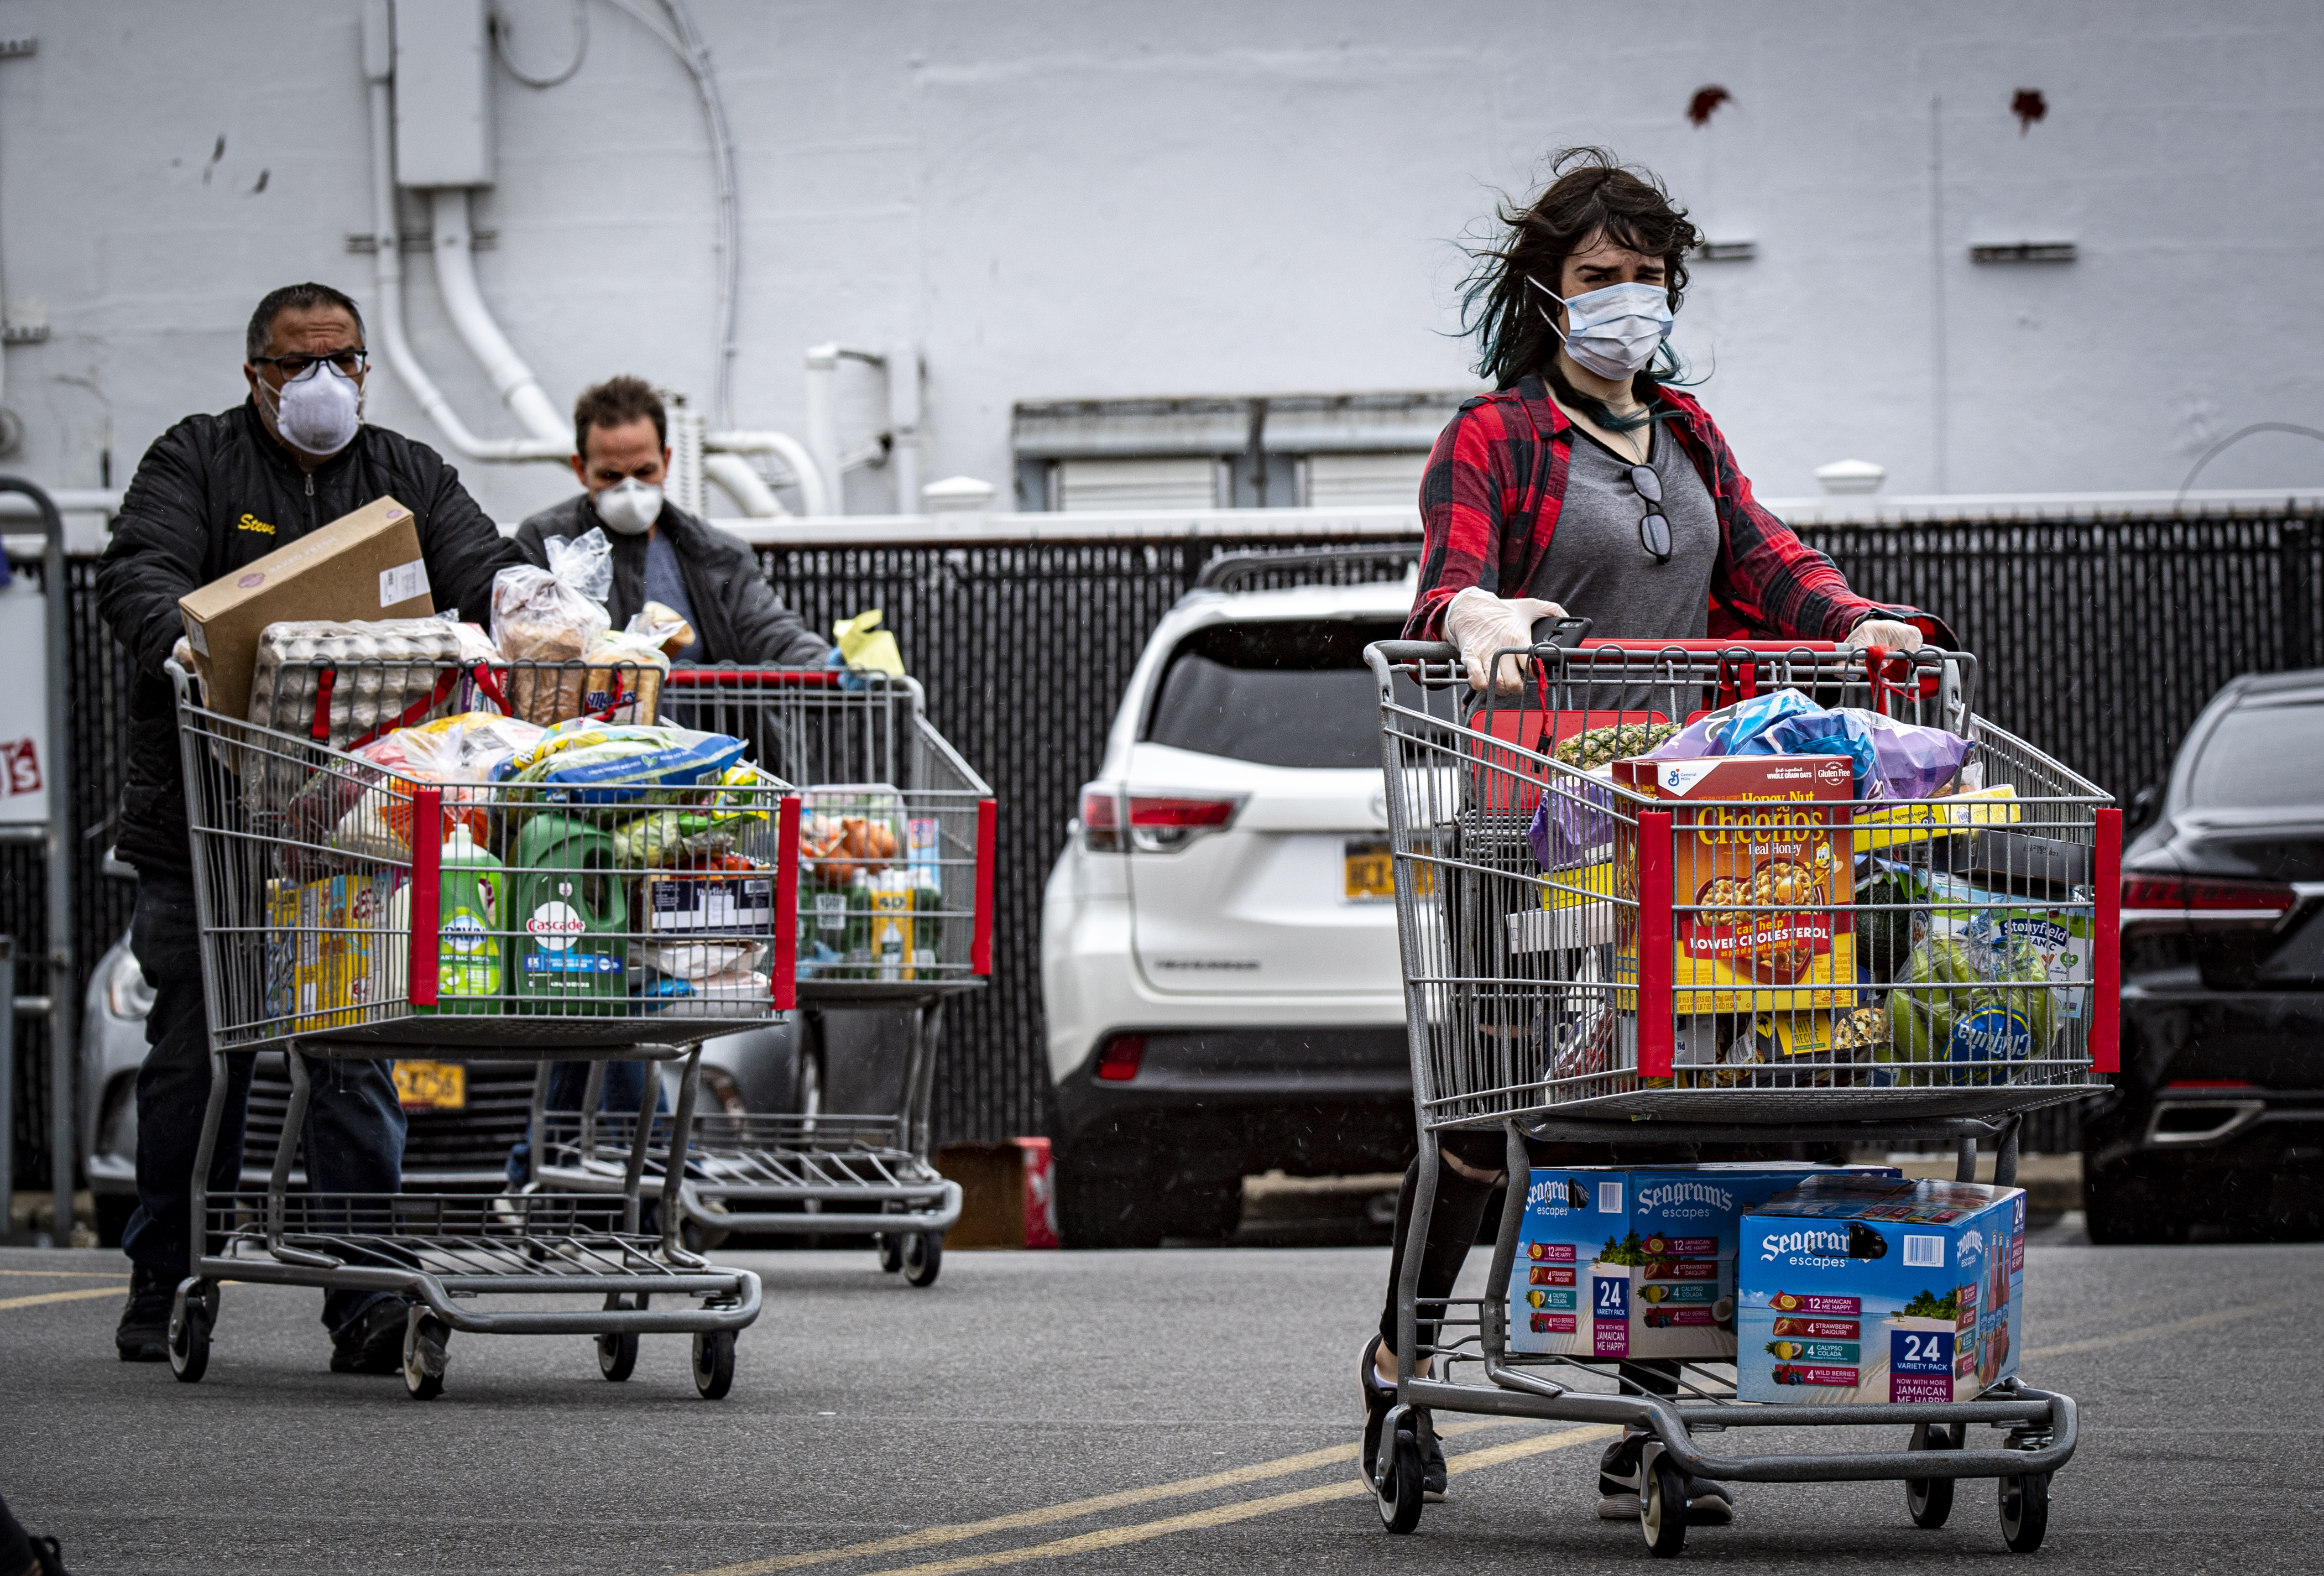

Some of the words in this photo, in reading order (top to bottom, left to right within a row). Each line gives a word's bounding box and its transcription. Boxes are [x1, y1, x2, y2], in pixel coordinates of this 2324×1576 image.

[238, 513, 276, 535] Steve
[1818, 769, 1838, 777] Gluten
[1698, 806, 1824, 844] Cheerios
[528, 918, 583, 933] Cascade
[1638, 1182, 1733, 1215] Seagram's
[1537, 1207, 1568, 1218] escapes
[1662, 1209, 1710, 1220] escapes
[2014, 1196, 2023, 1225] 24
[1674, 1240, 1684, 1251] 12
[1548, 1246, 1554, 1257] 12
[1789, 1256, 1846, 1270] escapes
[1673, 1265, 1679, 1275] 4
[1548, 1271, 1552, 1282] 4
[1600, 1281, 1621, 1307] 24
[1673, 1287, 1679, 1297] 4
[1548, 1293, 1552, 1303] 4
[1809, 1298, 1820, 1309] 12
[1548, 1317, 1553, 1327] 4
[1673, 1311, 1679, 1322] 4
[1807, 1323, 1815, 1334] 4
[1596, 1331, 1625, 1341] JAMAICAN
[1597, 1342, 1605, 1350] ME
[1807, 1345, 1815, 1356] 4
[1904, 1335, 1940, 1361] 24
[1807, 1369, 1814, 1380] 4
[1896, 1385, 1946, 1397] JAMAICAN
